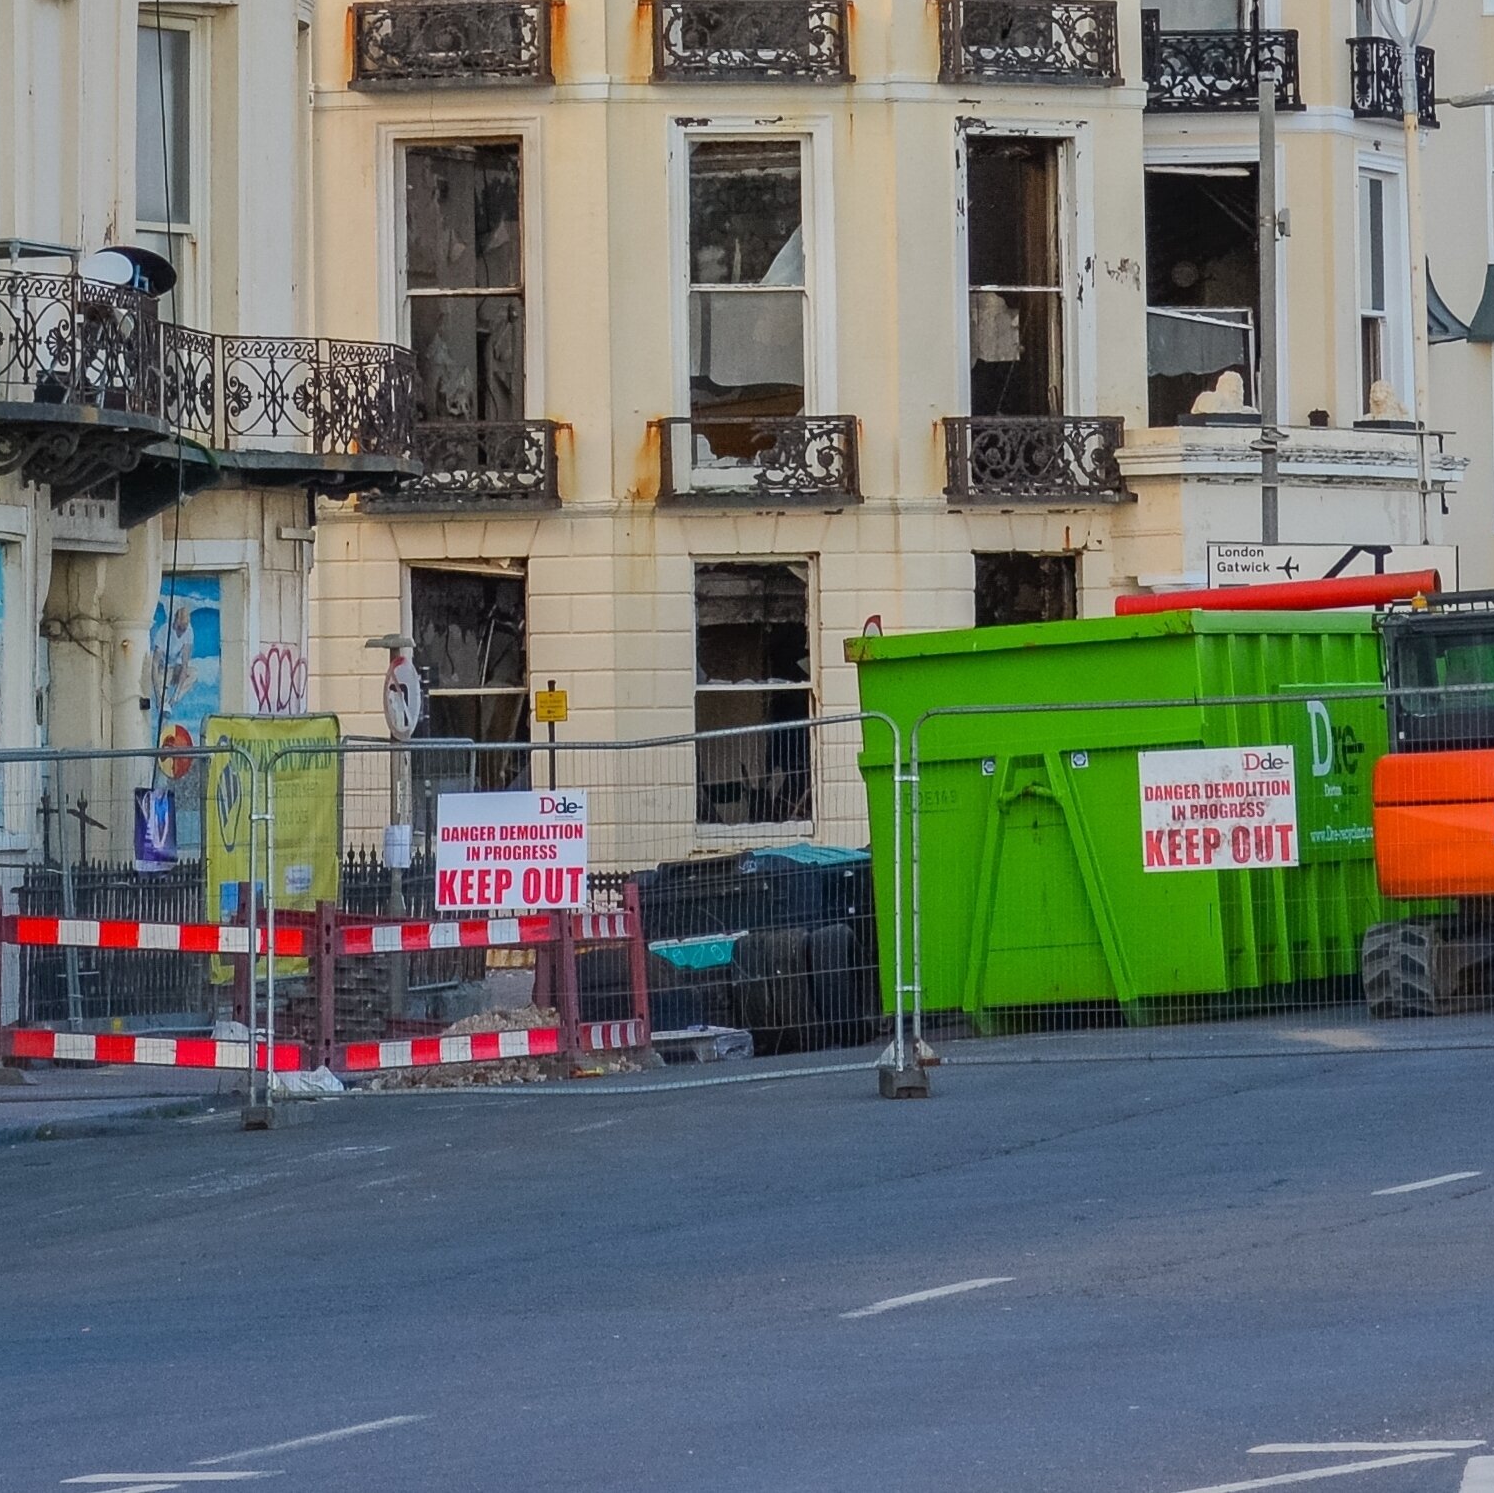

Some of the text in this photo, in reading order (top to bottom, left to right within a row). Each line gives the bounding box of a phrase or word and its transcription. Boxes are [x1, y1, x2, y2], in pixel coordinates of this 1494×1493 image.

[1217, 546, 1264, 557] London
[1217, 562, 1270, 572] Gatwick
[1144, 780, 1291, 801] DANGER DEMOLITION
[1171, 802, 1265, 821] IN PROGRESS
[441, 823, 584, 842] DANGER DEMOLITION
[466, 844, 557, 861] IN PROGRESS
[1144, 824, 1293, 867] KEEP OUT
[438, 867, 584, 905] KEEP OUT
